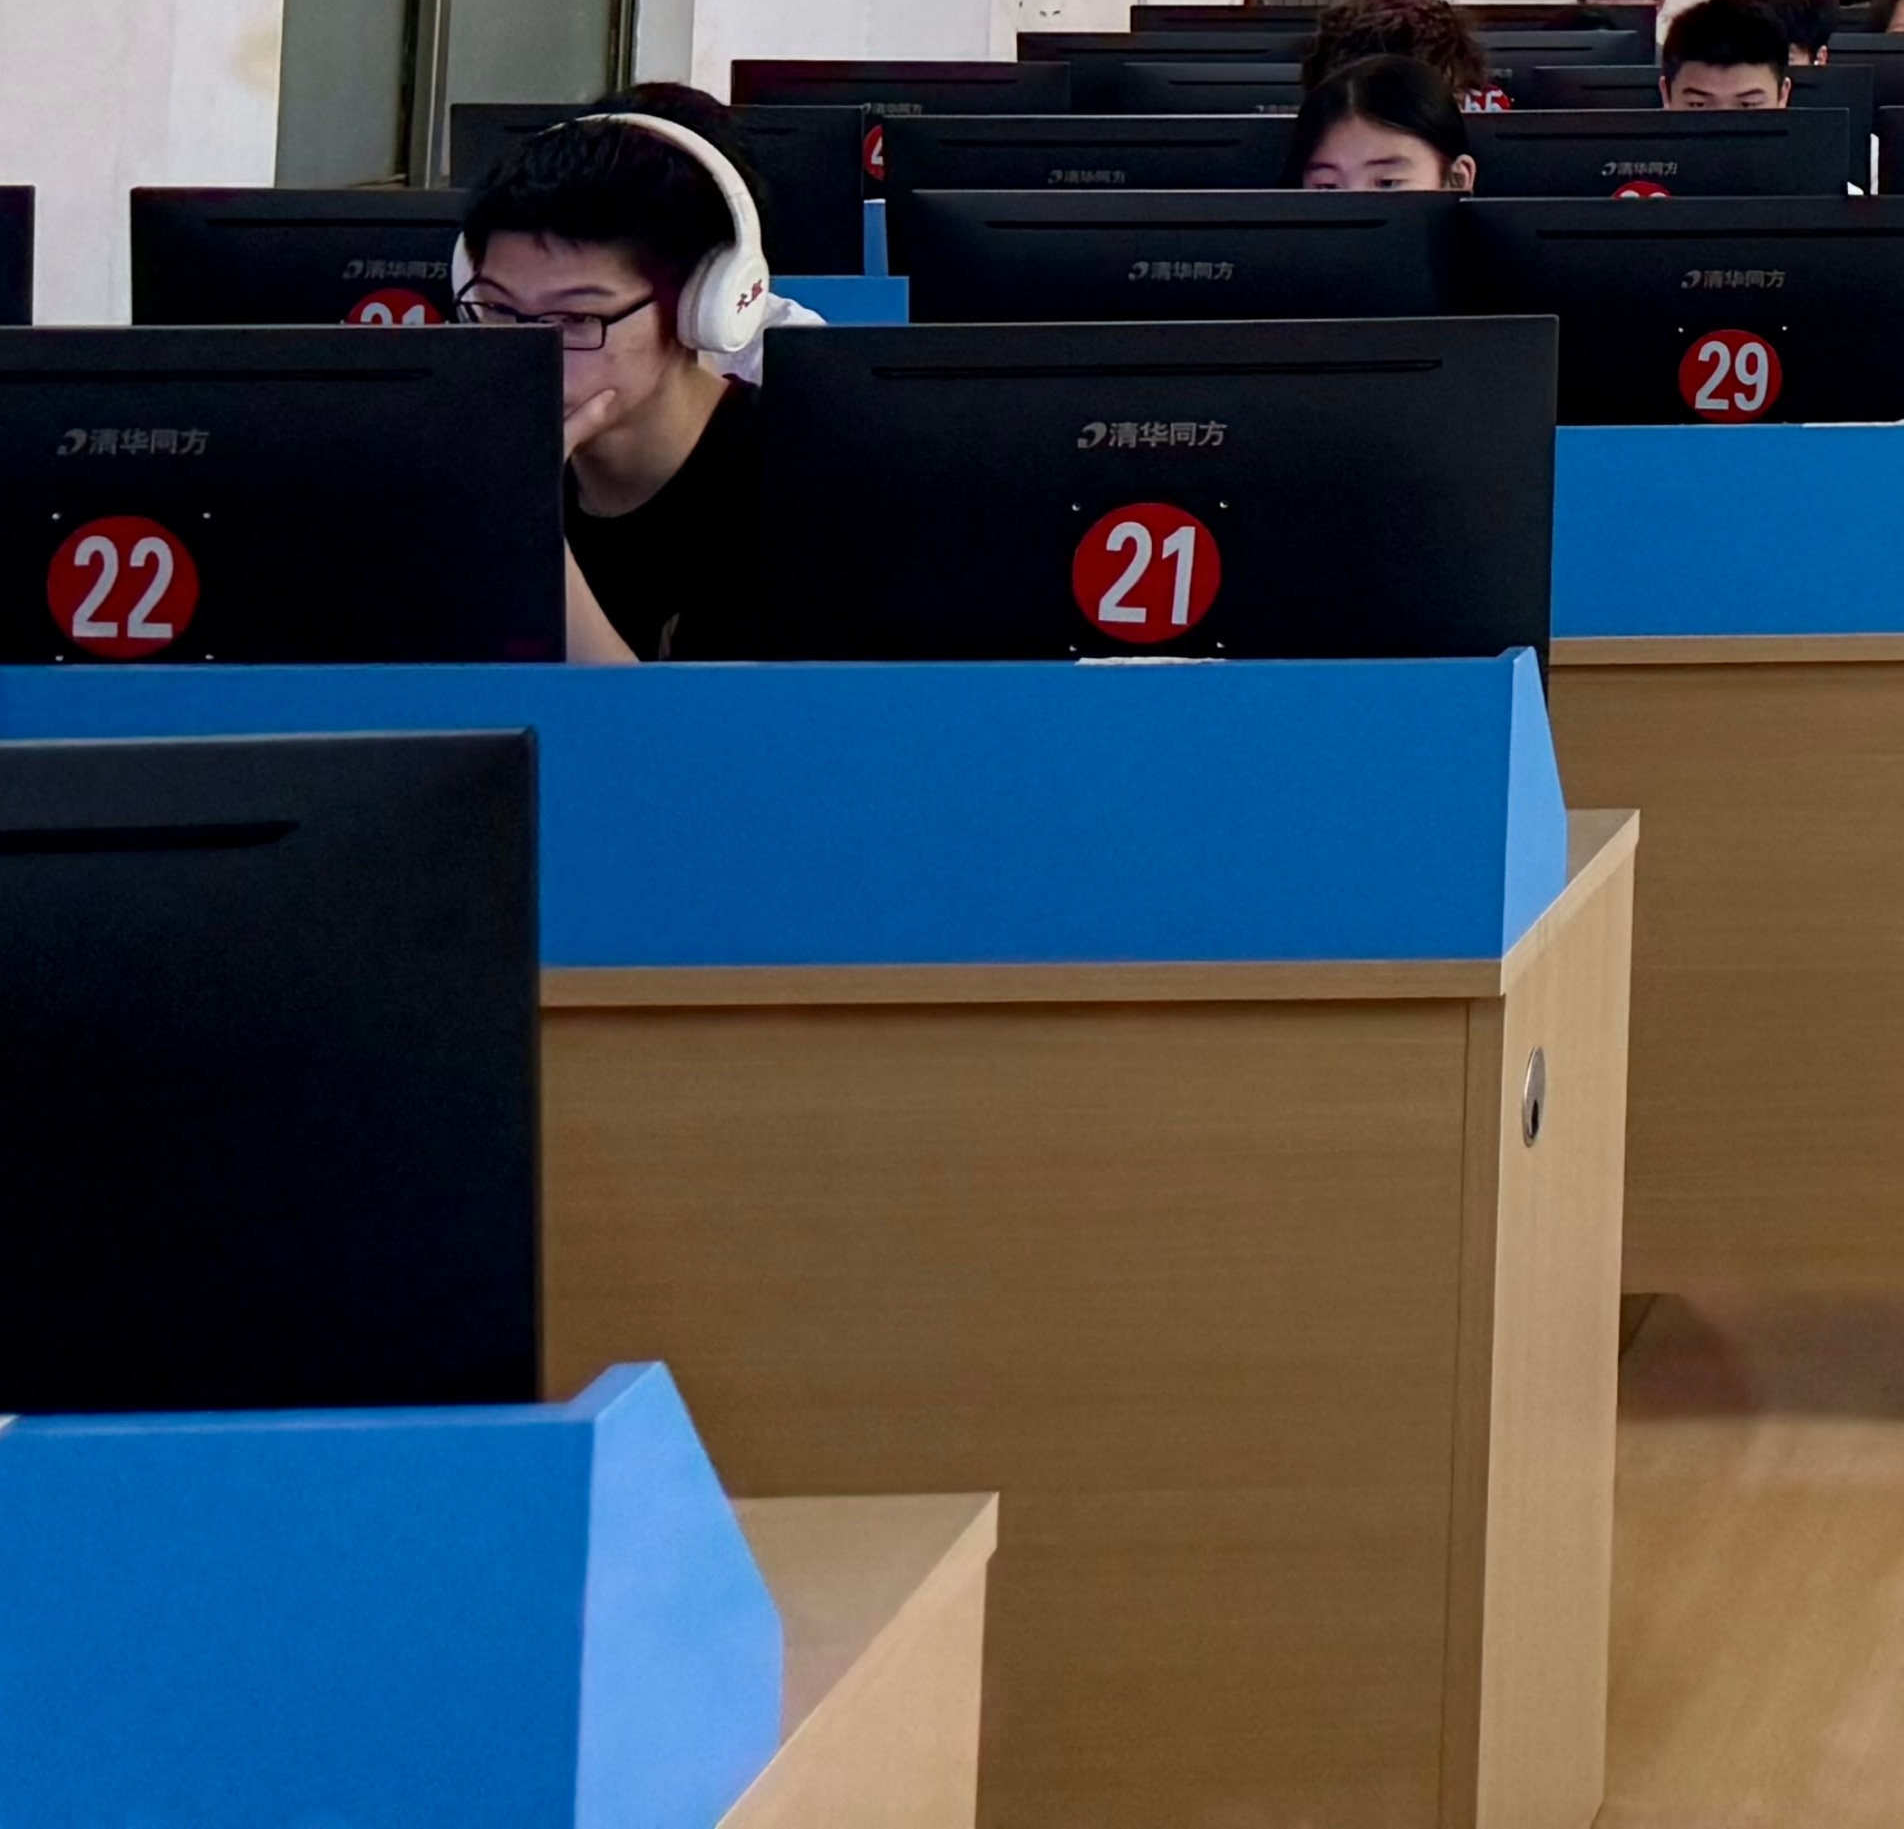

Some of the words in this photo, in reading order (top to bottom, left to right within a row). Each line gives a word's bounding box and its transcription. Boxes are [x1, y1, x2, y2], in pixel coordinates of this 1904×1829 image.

[1151, 261, 1234, 281] 清华同方
[1703, 269, 1786, 288] 清华同方
[1695, 340, 1769, 412] 29
[89, 428, 210, 456] 清华同方
[1108, 420, 1228, 449] 清华同方
[71, 535, 174, 640] 22
[1098, 521, 1196, 626] 21
